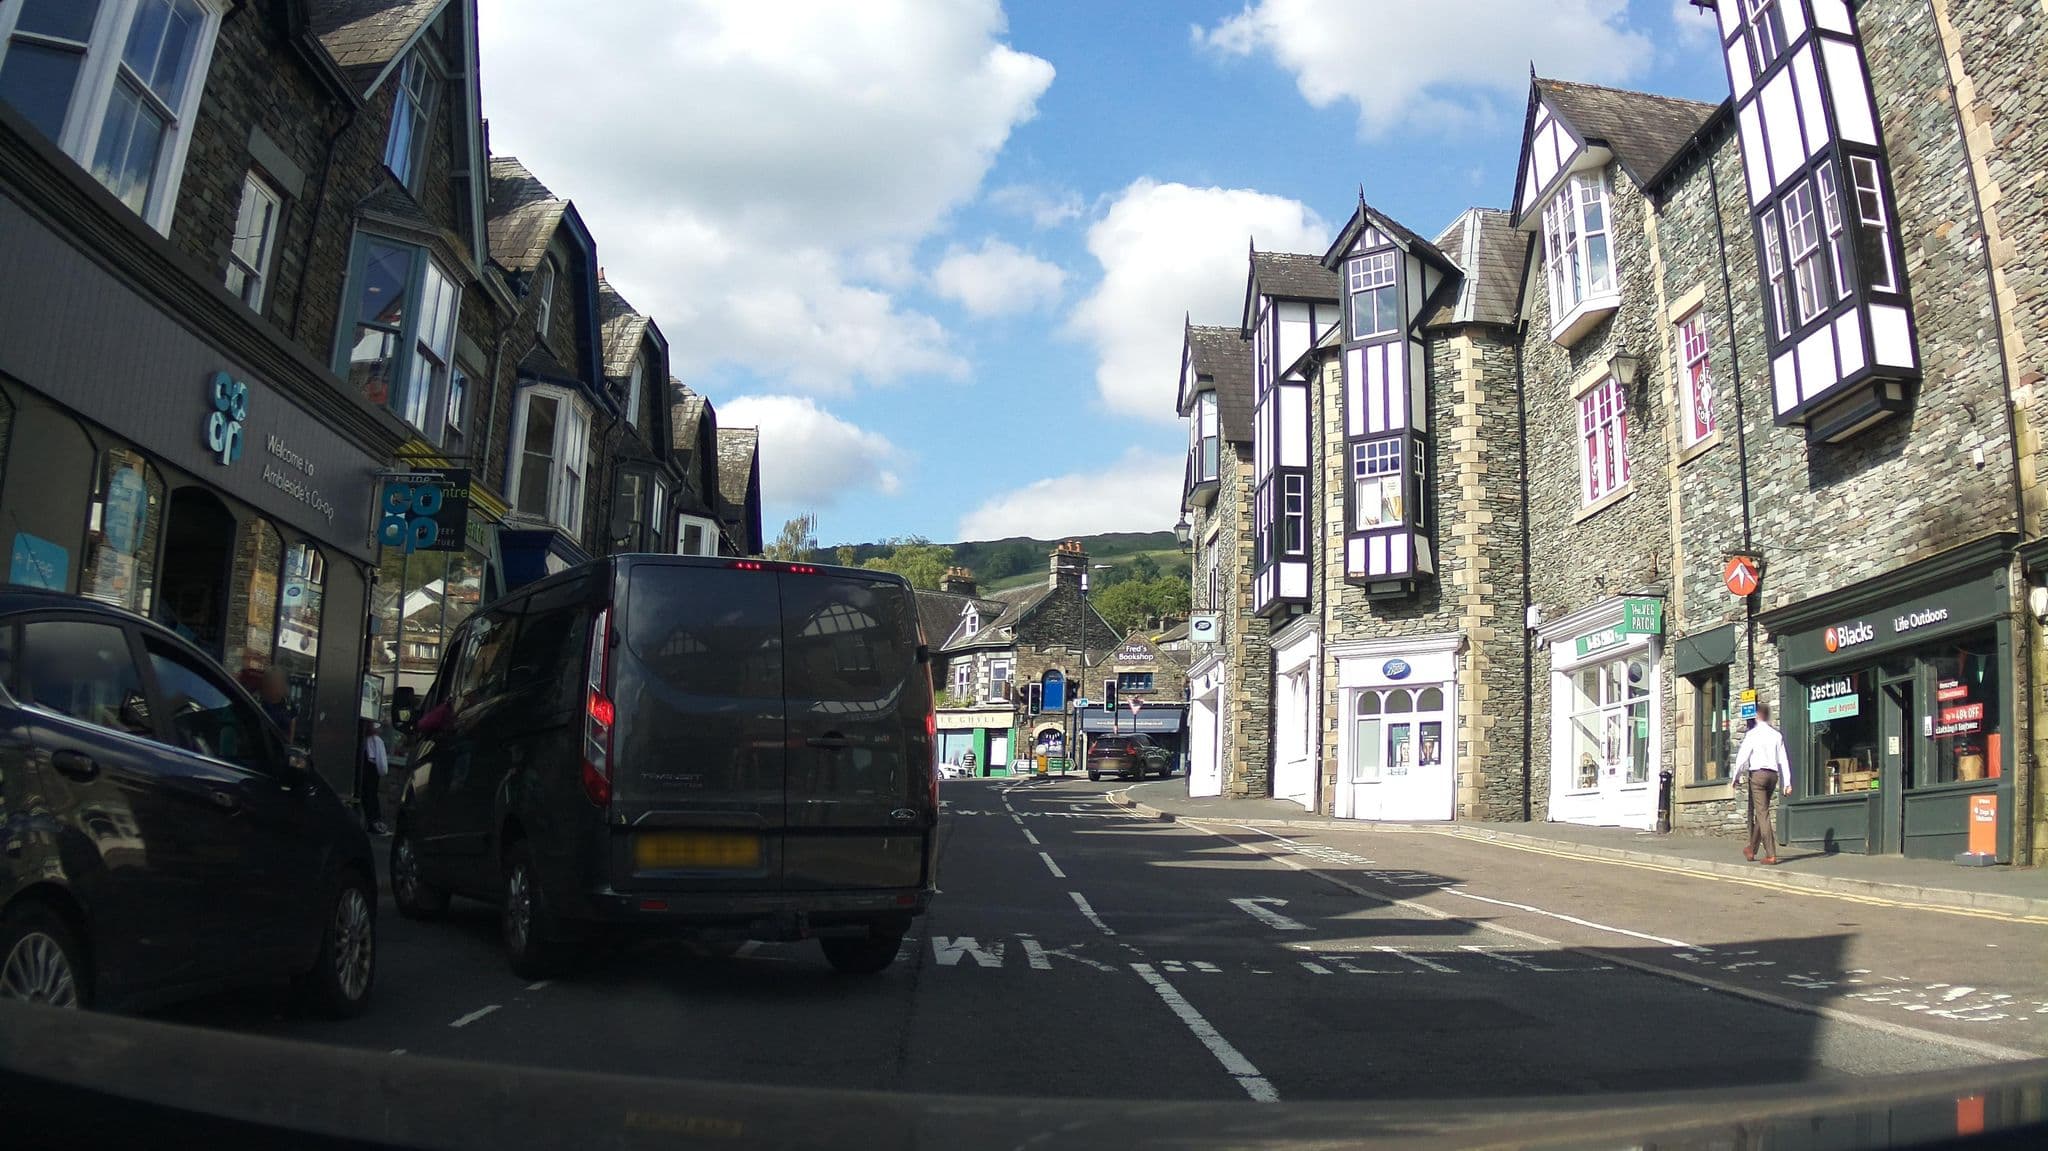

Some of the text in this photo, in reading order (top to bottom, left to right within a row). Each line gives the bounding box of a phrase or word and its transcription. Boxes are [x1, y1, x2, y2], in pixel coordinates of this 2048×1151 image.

[267, 433, 315, 477] Welcome to
[262, 463, 335, 527] Ambleside's Co-op
[1632, 616, 1655, 630] PATCH
[1894, 608, 1948, 632] Life Outdoors
[1837, 621, 1874, 648] Blacks
[1118, 653, 1154, 662] Bookshop
[1126, 645, 1147, 653] Fred's
[1968, 706, 1980, 718] OFF
